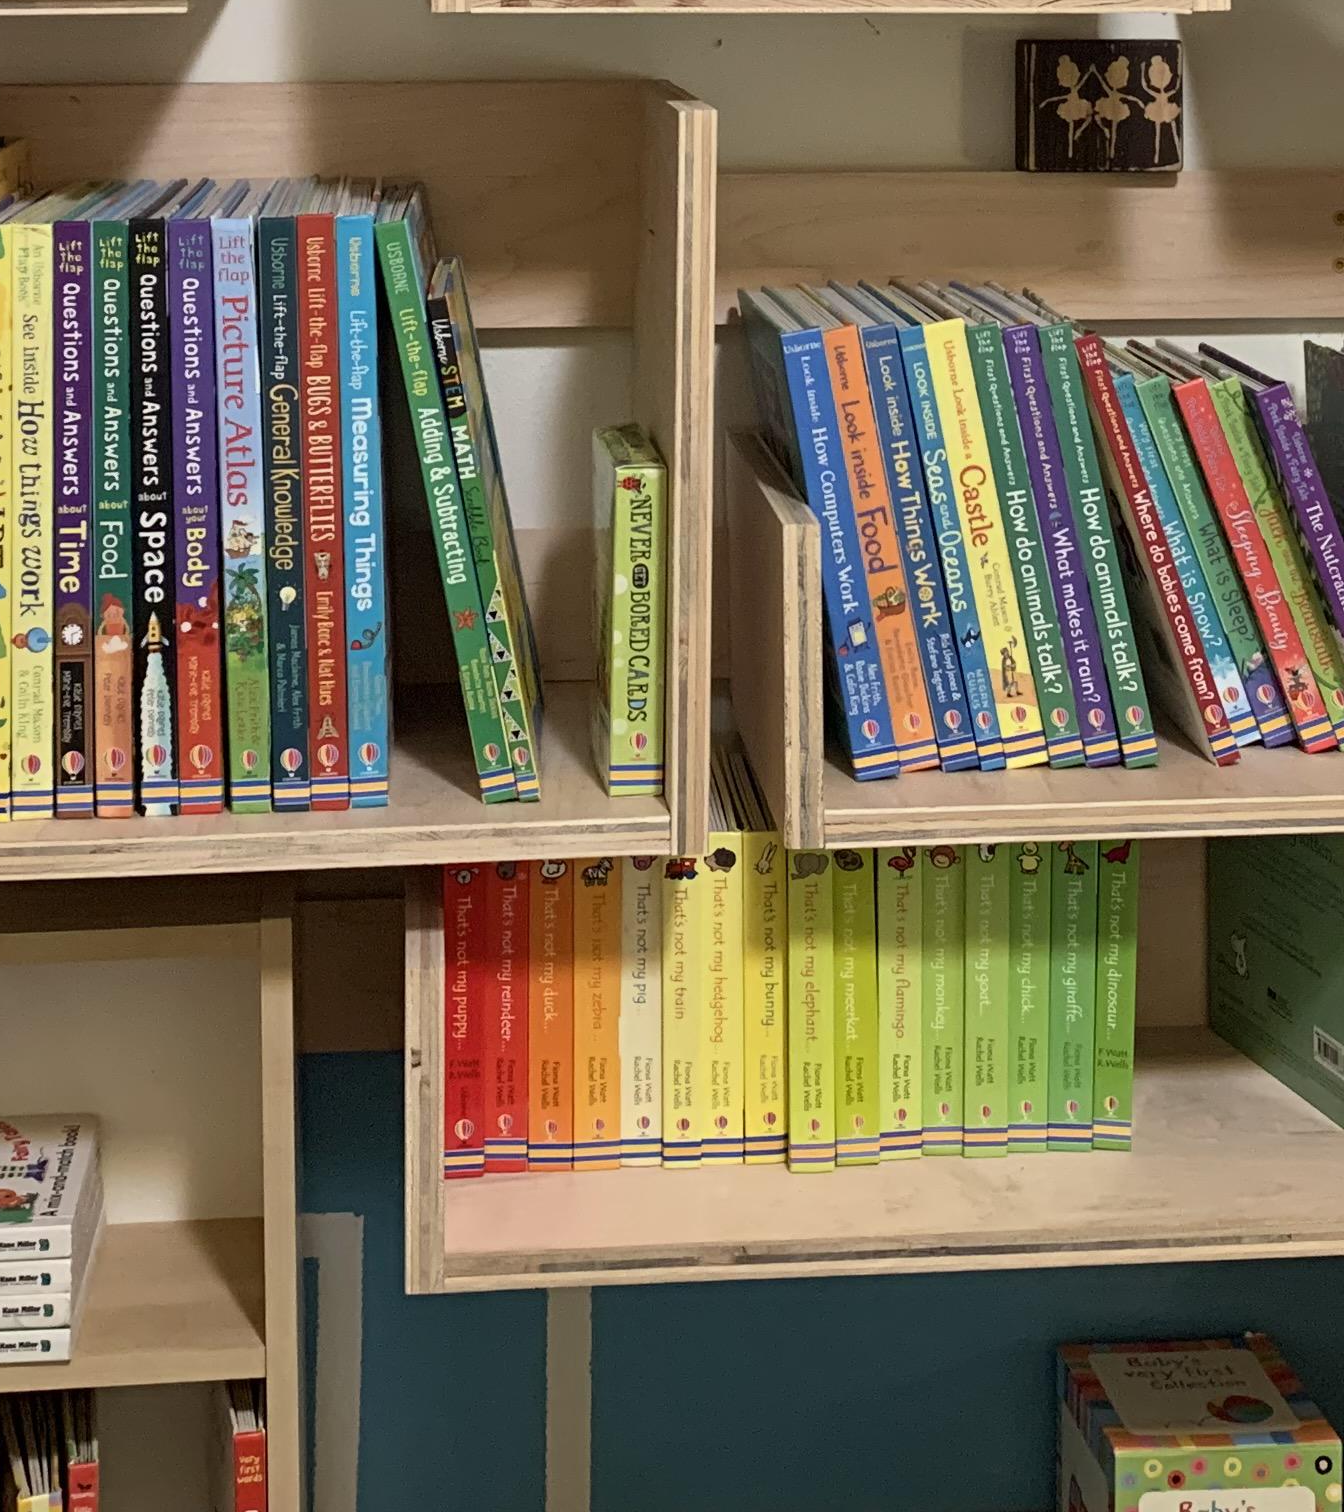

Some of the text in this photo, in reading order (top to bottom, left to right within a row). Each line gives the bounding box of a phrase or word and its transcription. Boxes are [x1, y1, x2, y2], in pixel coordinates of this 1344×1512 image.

[222, 295, 255, 507] Picture Atlas
[270, 383, 299, 571] General Knowledge
[307, 375, 335, 544] BUGS & BUTTERFLIES
[350, 397, 376, 612] Measuring Things
[99, 521, 128, 580] Food
[813, 428, 855, 615] How Computers Work
[857, 507, 897, 574] Food
[960, 465, 994, 548] Castle
[1306, 501, 1325, 531] The
[59, 521, 86, 594] Time
[139, 512, 166, 603] Space
[182, 527, 206, 589] Body
[627, 494, 651, 723] NEVER BORED CARDS
